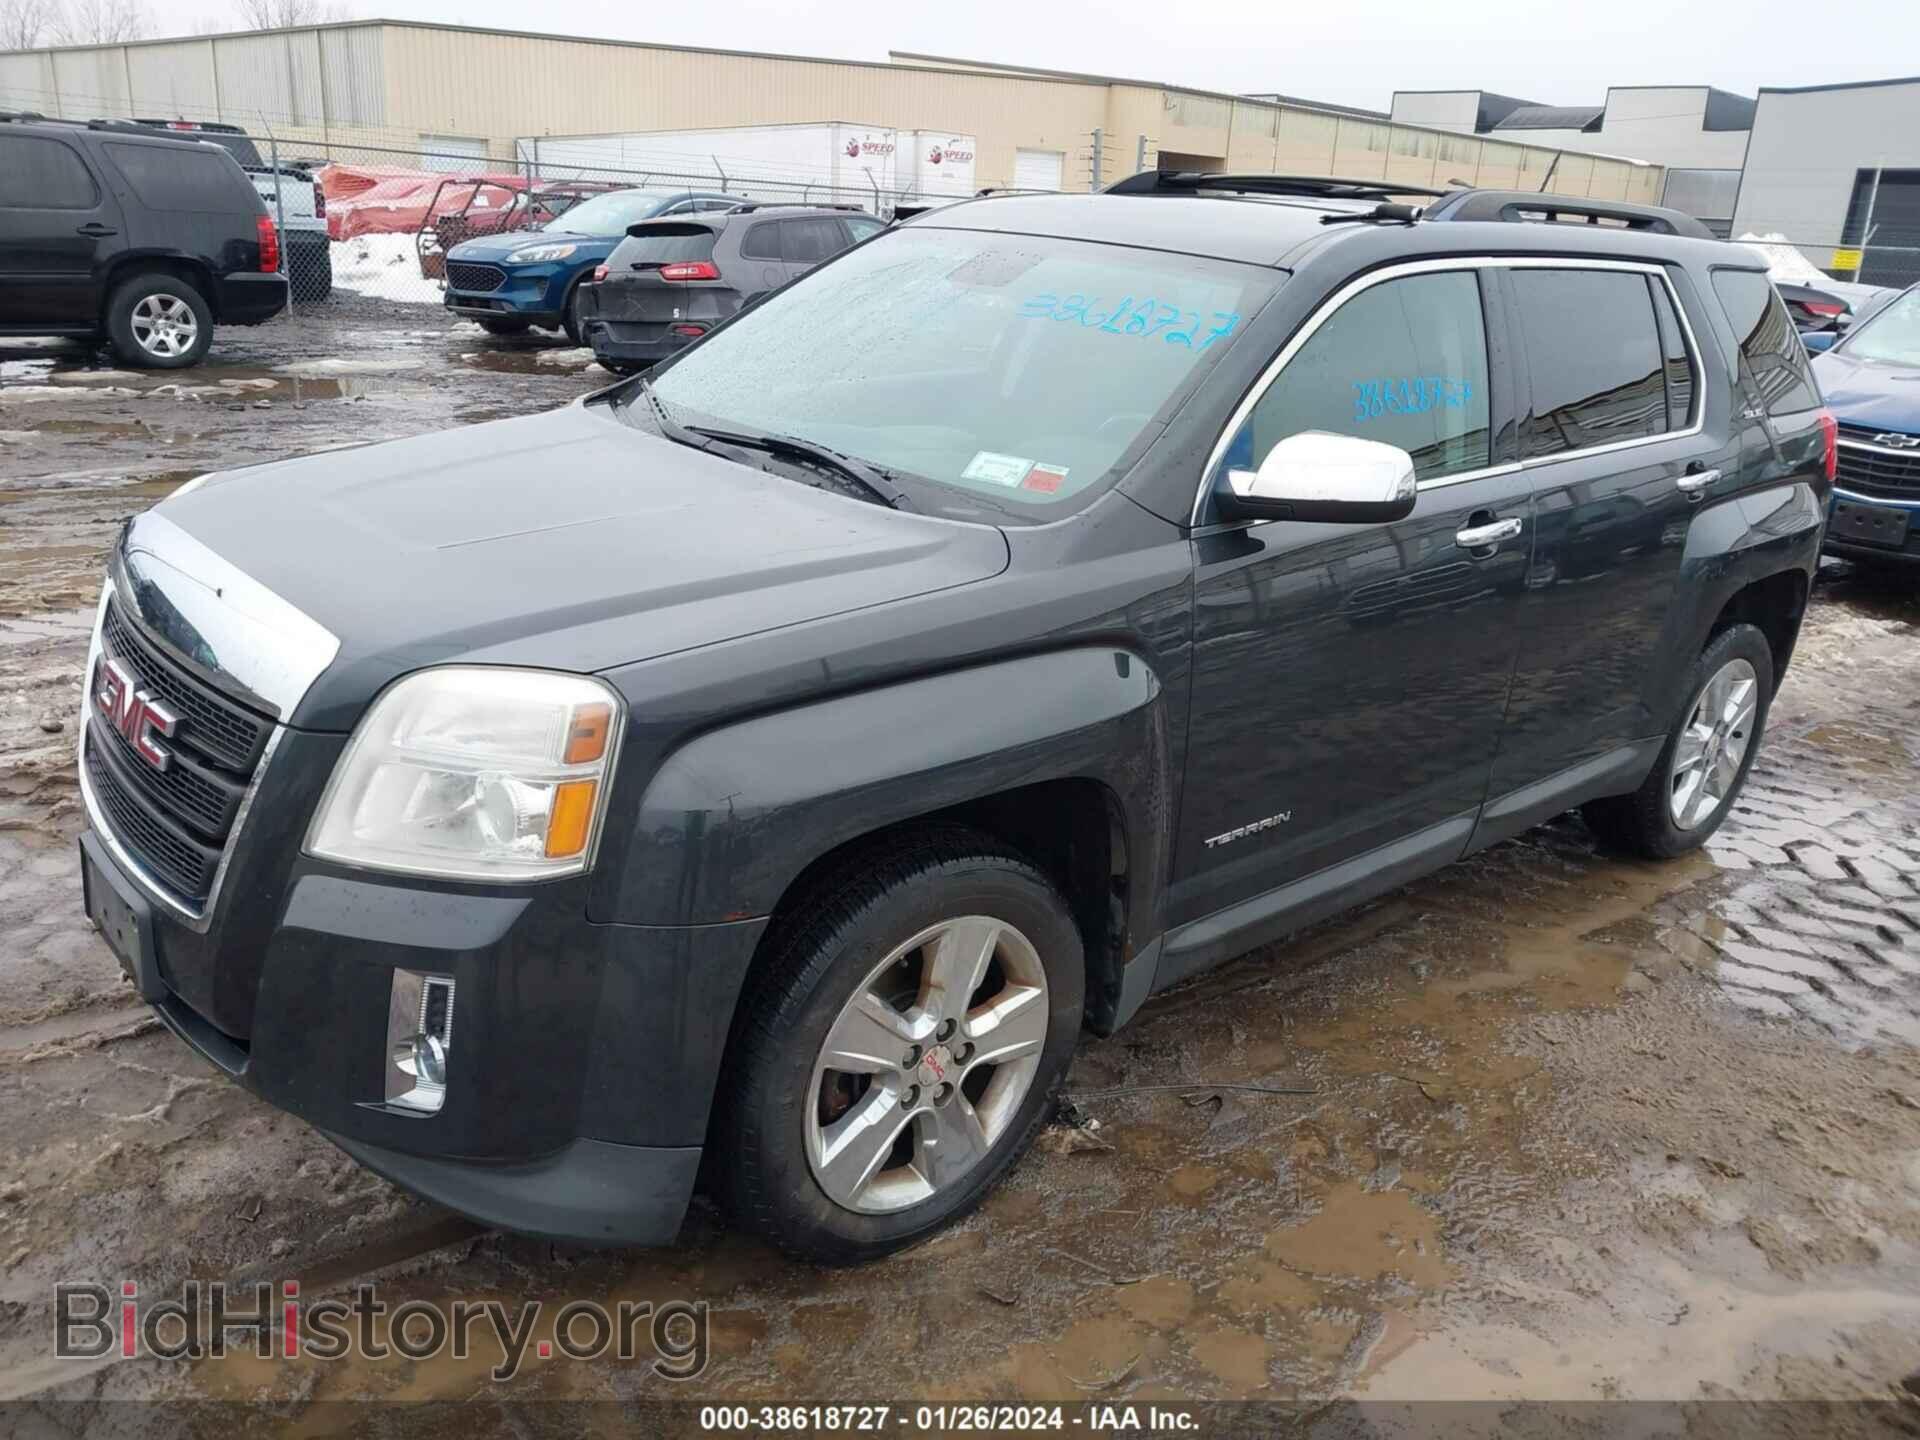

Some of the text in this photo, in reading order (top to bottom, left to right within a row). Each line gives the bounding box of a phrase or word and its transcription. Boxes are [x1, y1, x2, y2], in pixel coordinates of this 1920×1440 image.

[862, 142, 894, 154] SPEED
[943, 150, 973, 161] SPEED
[95, 660, 176, 772] GMC
[1204, 810, 1292, 849] TERRAIN
[925, 1053, 945, 1081] GMC
